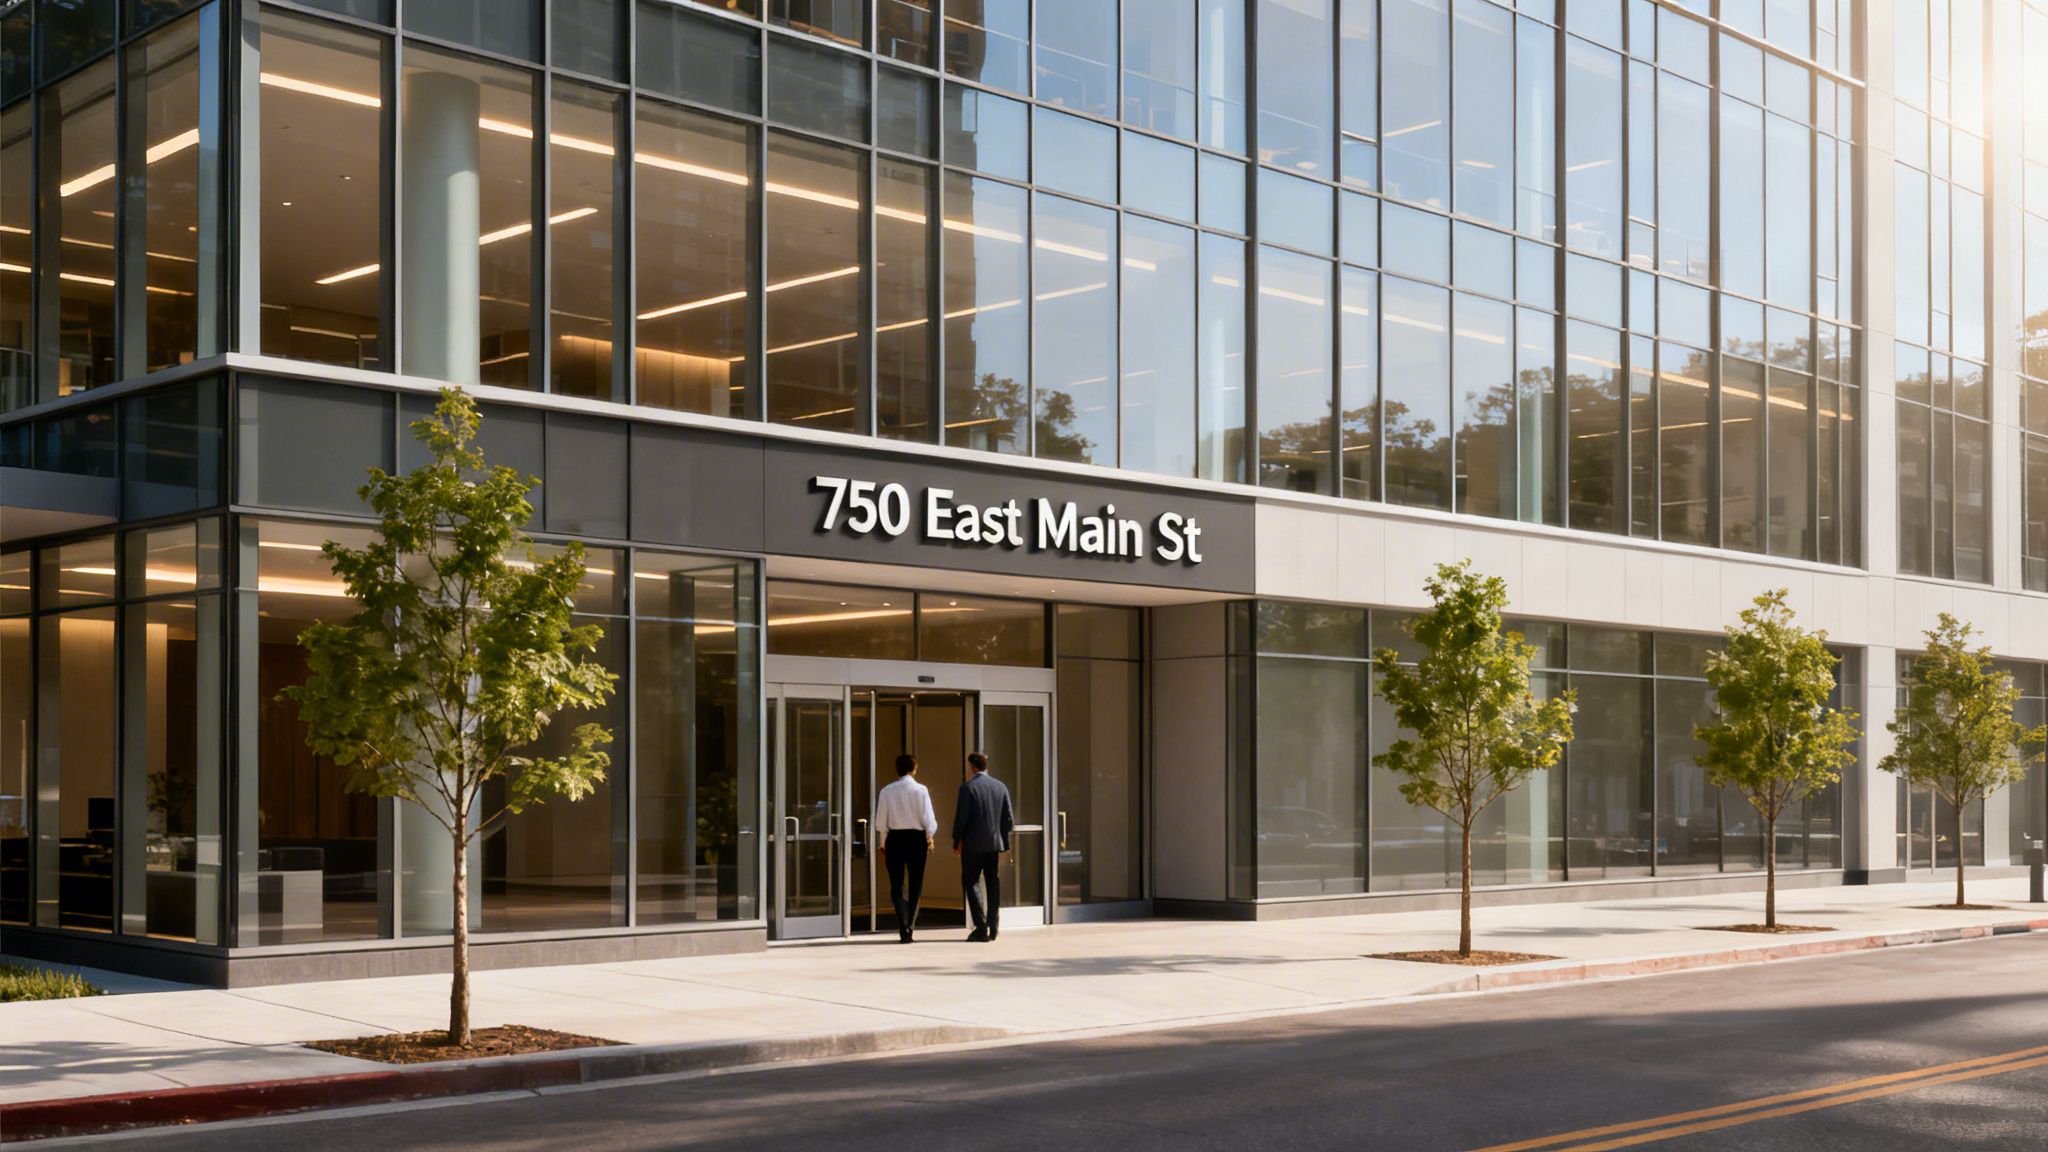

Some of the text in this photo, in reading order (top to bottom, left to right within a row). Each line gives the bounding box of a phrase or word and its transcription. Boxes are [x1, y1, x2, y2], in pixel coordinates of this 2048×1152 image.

[814, 475, 1203, 564] 750 East Main St
